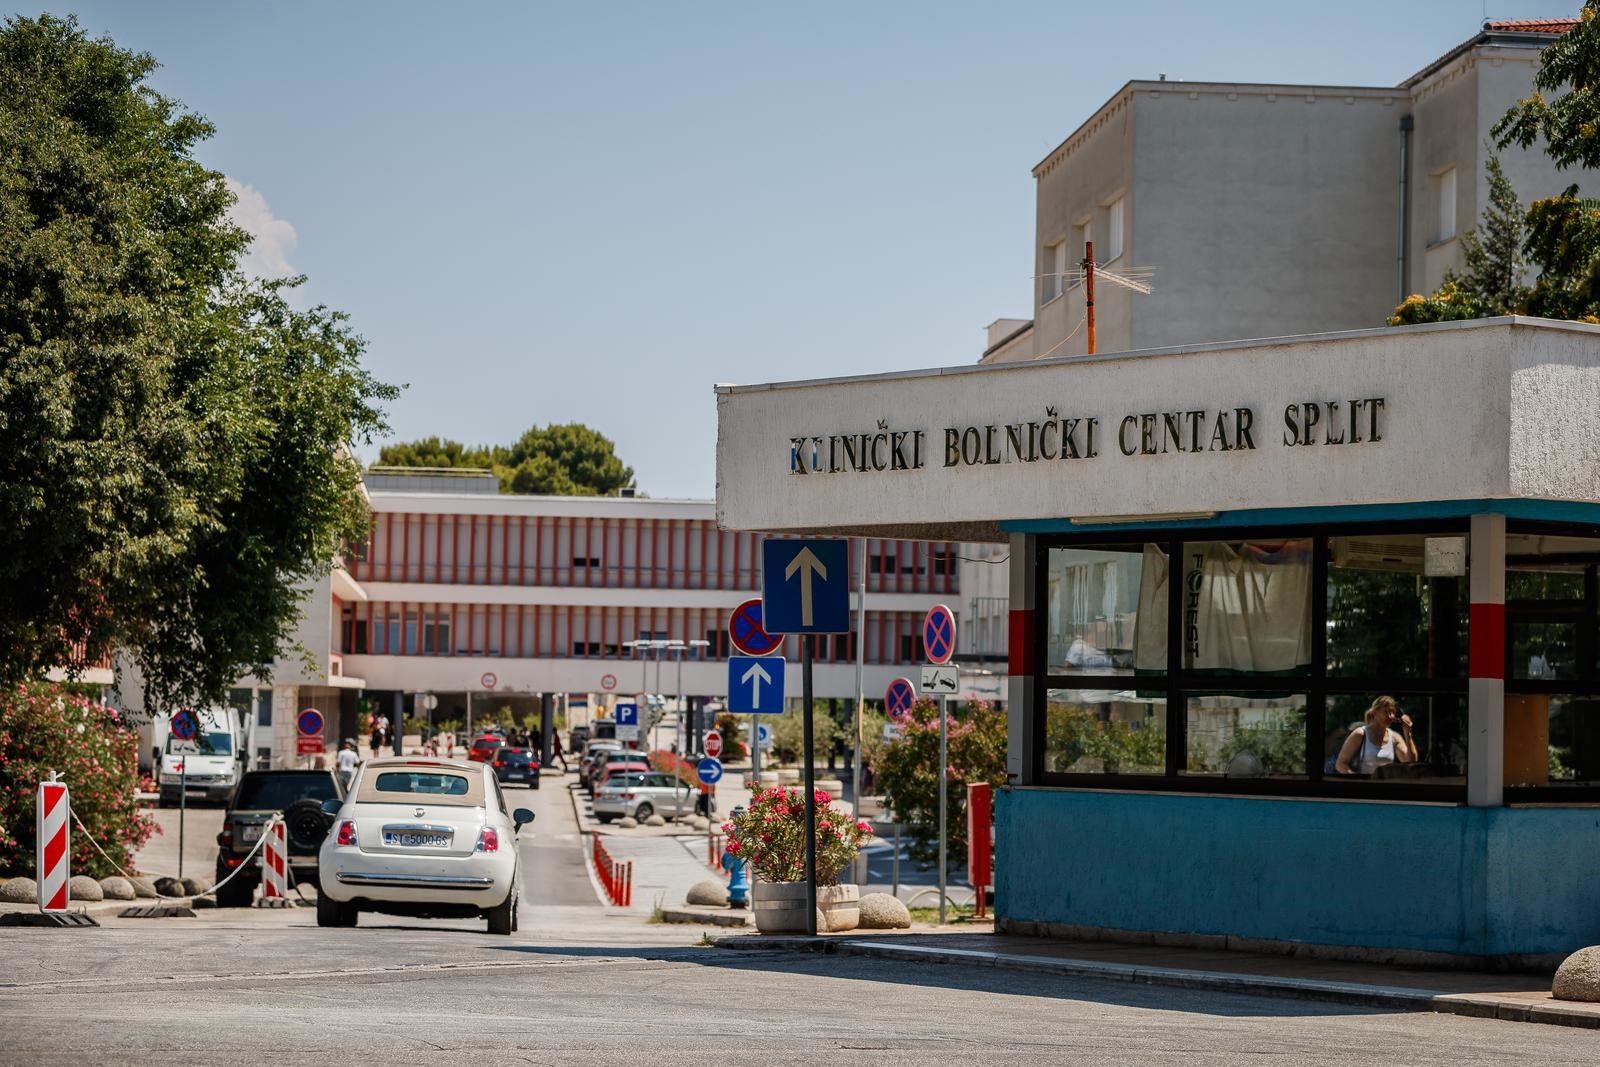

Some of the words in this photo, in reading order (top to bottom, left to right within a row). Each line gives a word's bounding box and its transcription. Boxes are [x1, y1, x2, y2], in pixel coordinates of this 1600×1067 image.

[790, 419, 924, 475] KLINIČKI
[943, 406, 1099, 468] BOLNIČKI
[1118, 407, 1257, 457] CENTAR
[1283, 398, 1386, 448] SPLIT
[1186, 553, 1204, 658] FOREST
[621, 707, 632, 722] P
